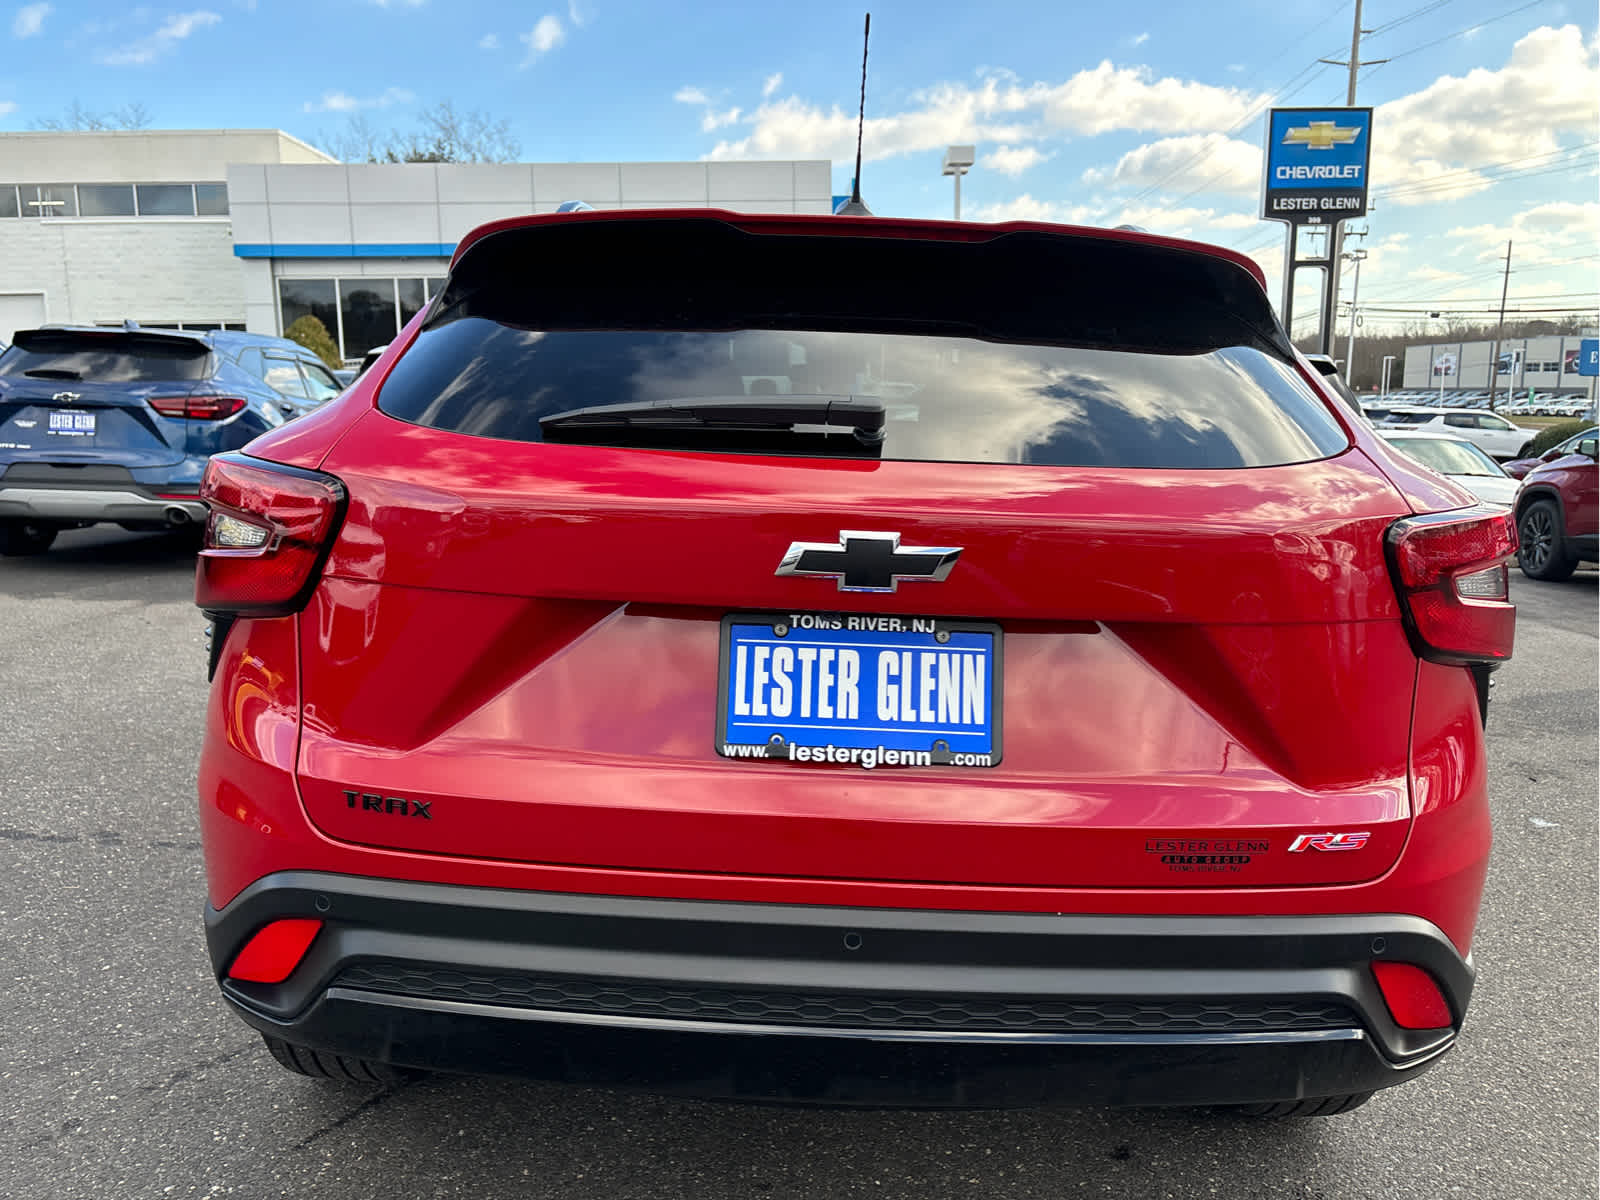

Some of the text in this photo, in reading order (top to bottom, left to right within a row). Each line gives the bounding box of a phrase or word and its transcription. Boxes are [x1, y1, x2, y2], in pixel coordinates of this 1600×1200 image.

[1276, 165, 1362, 179] CHEVROLET
[1273, 197, 1360, 210] LESTER GLENN
[790, 614, 936, 634] TOMS RIVER, NJ
[733, 645, 986, 725] LESTER GLENN
[723, 742, 992, 768] www. lesterglenn .com
[342, 790, 432, 819] TRAX
[1145, 841, 1270, 852] LESTER GLENN
[1287, 831, 1371, 852] RS
[1164, 856, 1248, 864] AUTO GROUP
